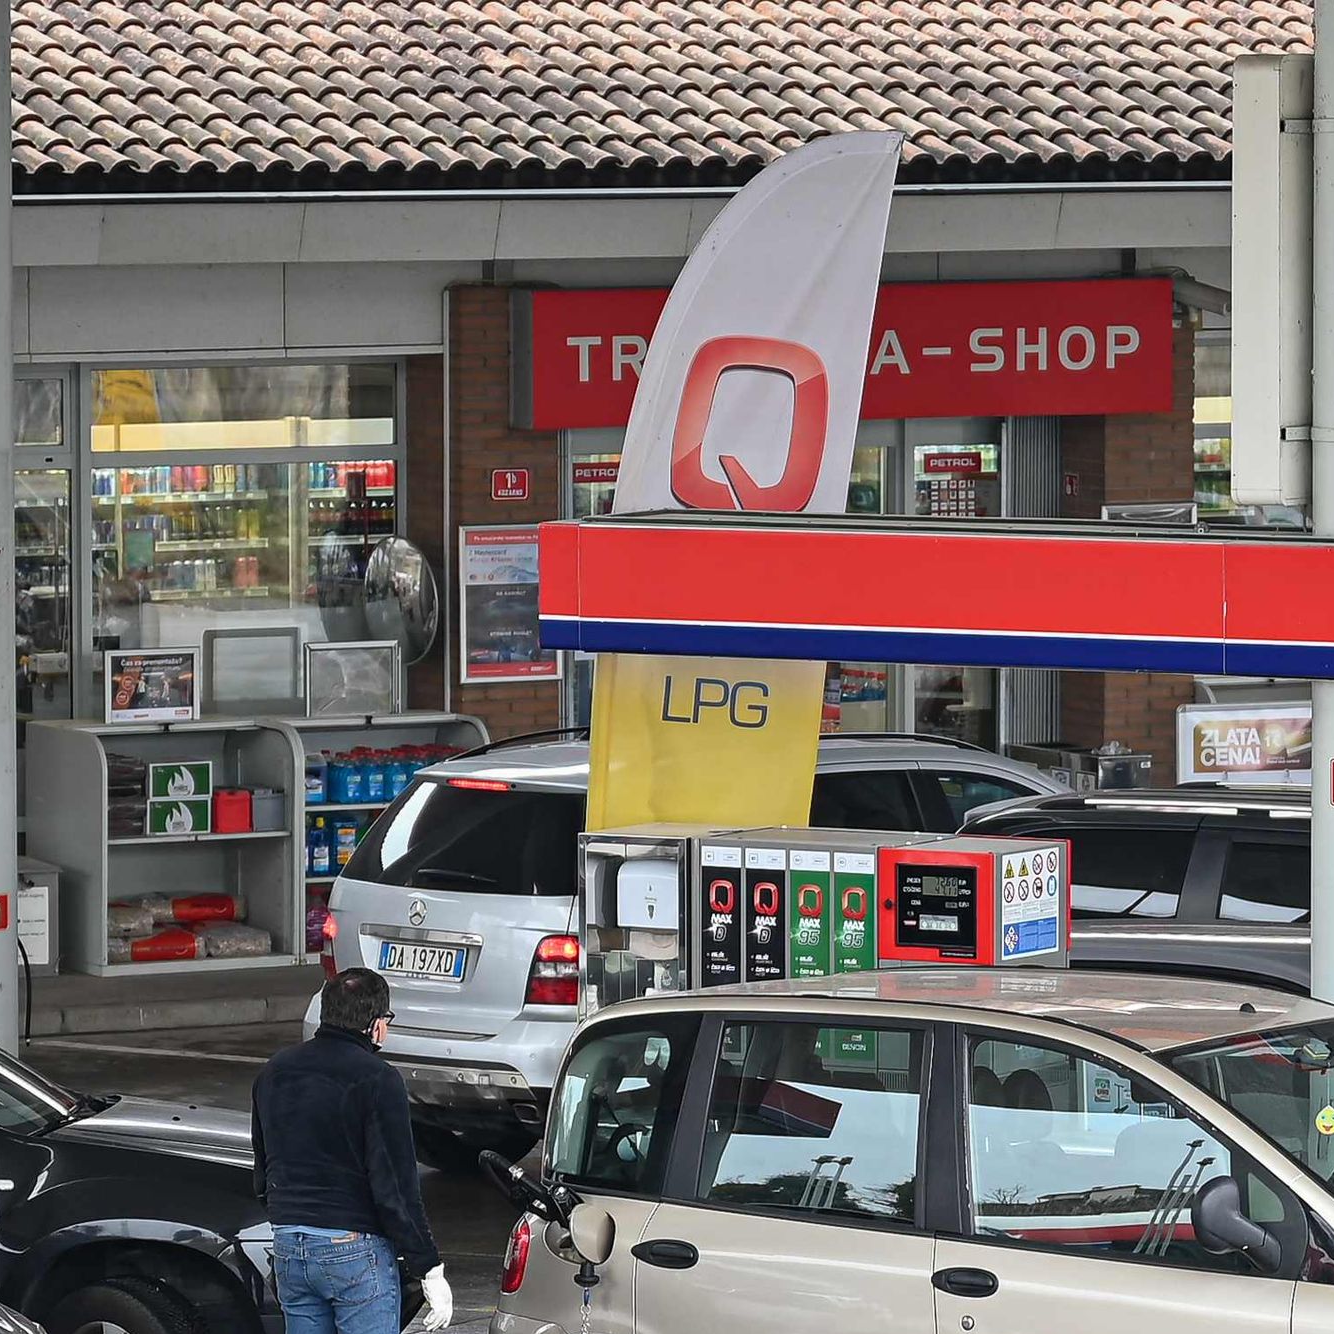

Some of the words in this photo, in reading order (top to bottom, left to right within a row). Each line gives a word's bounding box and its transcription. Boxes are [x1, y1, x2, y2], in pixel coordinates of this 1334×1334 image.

[670, 334, 829, 511] Q
[929, 457, 977, 468] PETROL
[661, 675, 769, 729] LPG
[1200, 728, 1261, 747] ZLATA
[1200, 747, 1261, 767] CENA!
[709, 879, 734, 914] Q
[753, 882, 779, 916] Q
[798, 883, 824, 918] Q
[842, 886, 868, 921] Q
[711, 913, 733, 924] MAX
[755, 915, 777, 927] MAX
[799, 918, 820, 929] MAX
[843, 920, 865, 931] MAX
[798, 929, 820, 945] 95
[842, 932, 865, 948] 95
[388, 945, 405, 969] DA
[411, 947, 454, 973] 197XD
